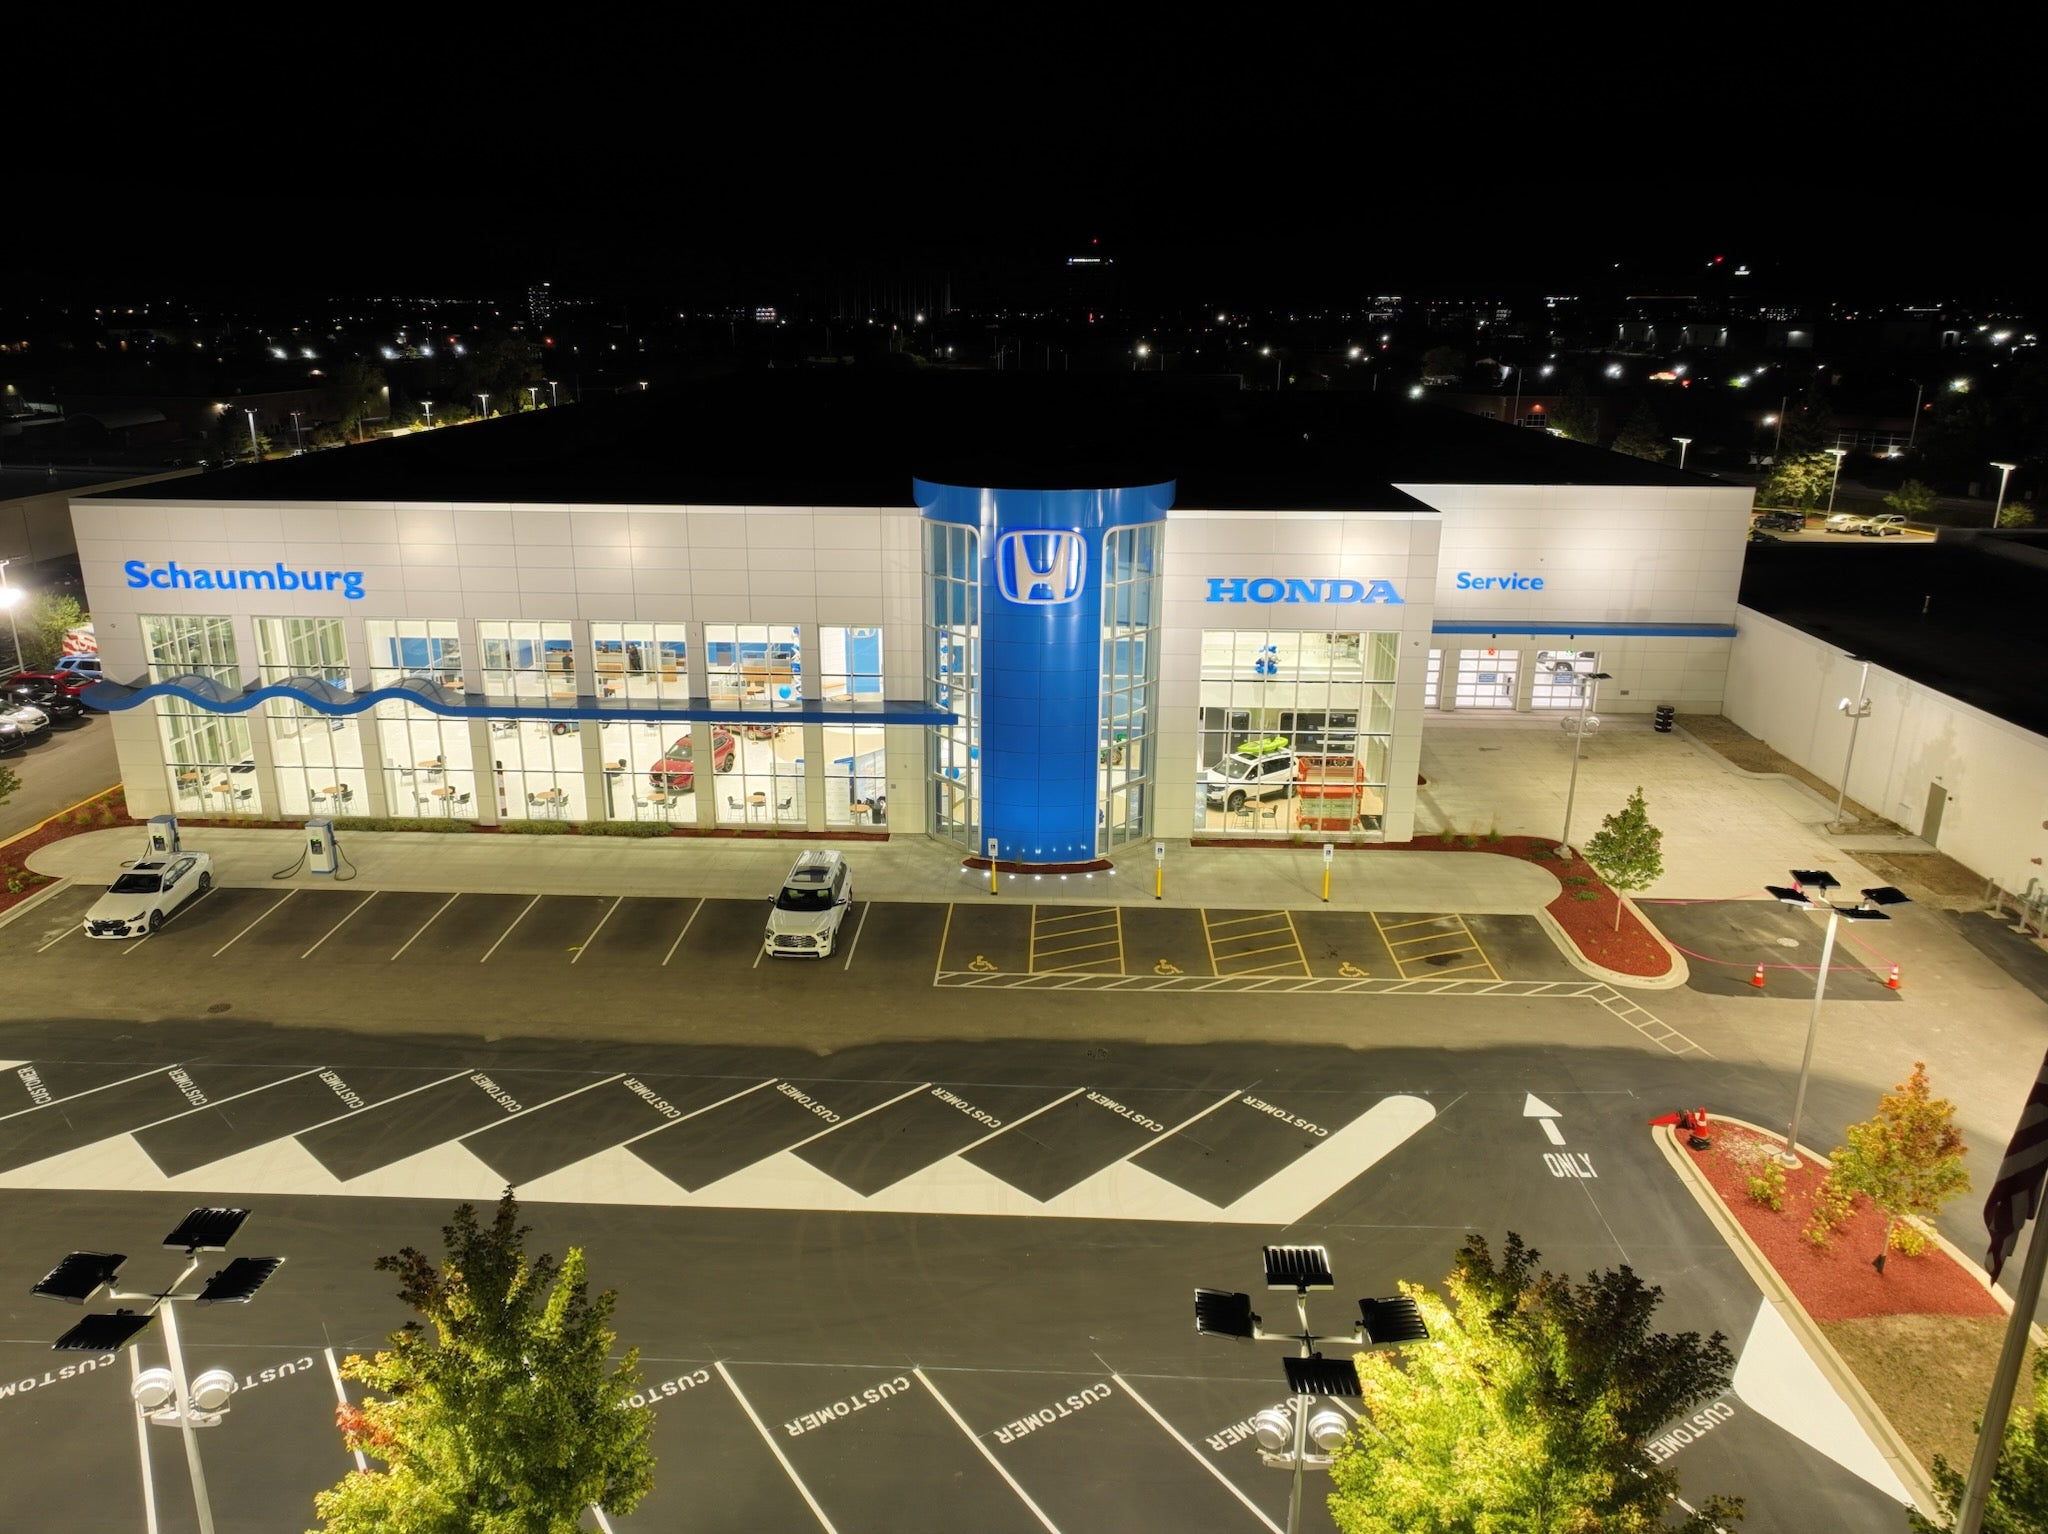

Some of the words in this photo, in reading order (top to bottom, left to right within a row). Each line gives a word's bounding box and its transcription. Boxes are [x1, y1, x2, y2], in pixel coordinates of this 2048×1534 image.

[124, 560, 366, 600] Schaumburg
[1206, 578, 1406, 604] HONDA
[1456, 571, 1545, 590] Service
[17, 1066, 52, 1105] CUSTOMER
[168, 1068, 208, 1106] CUSTOMER
[319, 1070, 365, 1109] CUSTOMER
[470, 1073, 523, 1113] CUSTOMER
[623, 1077, 682, 1119] CUSTOMER
[776, 1082, 840, 1123] CUSTOMER
[931, 1087, 1002, 1128] CUSTOMER
[1086, 1091, 1164, 1133] CUSTOMER
[1242, 1095, 1329, 1138] CUSTOMER
[1543, 1153, 1599, 1178] ONLY
[0, 1353, 116, 1399] CUSTOM
[231, 1357, 314, 1393] CUST
[613, 1370, 711, 1411] CUSTO
[784, 1377, 911, 1437] CUSTOMER
[993, 1383, 1112, 1445] CUSTOMER
[1206, 1395, 1316, 1451] CUSMER
